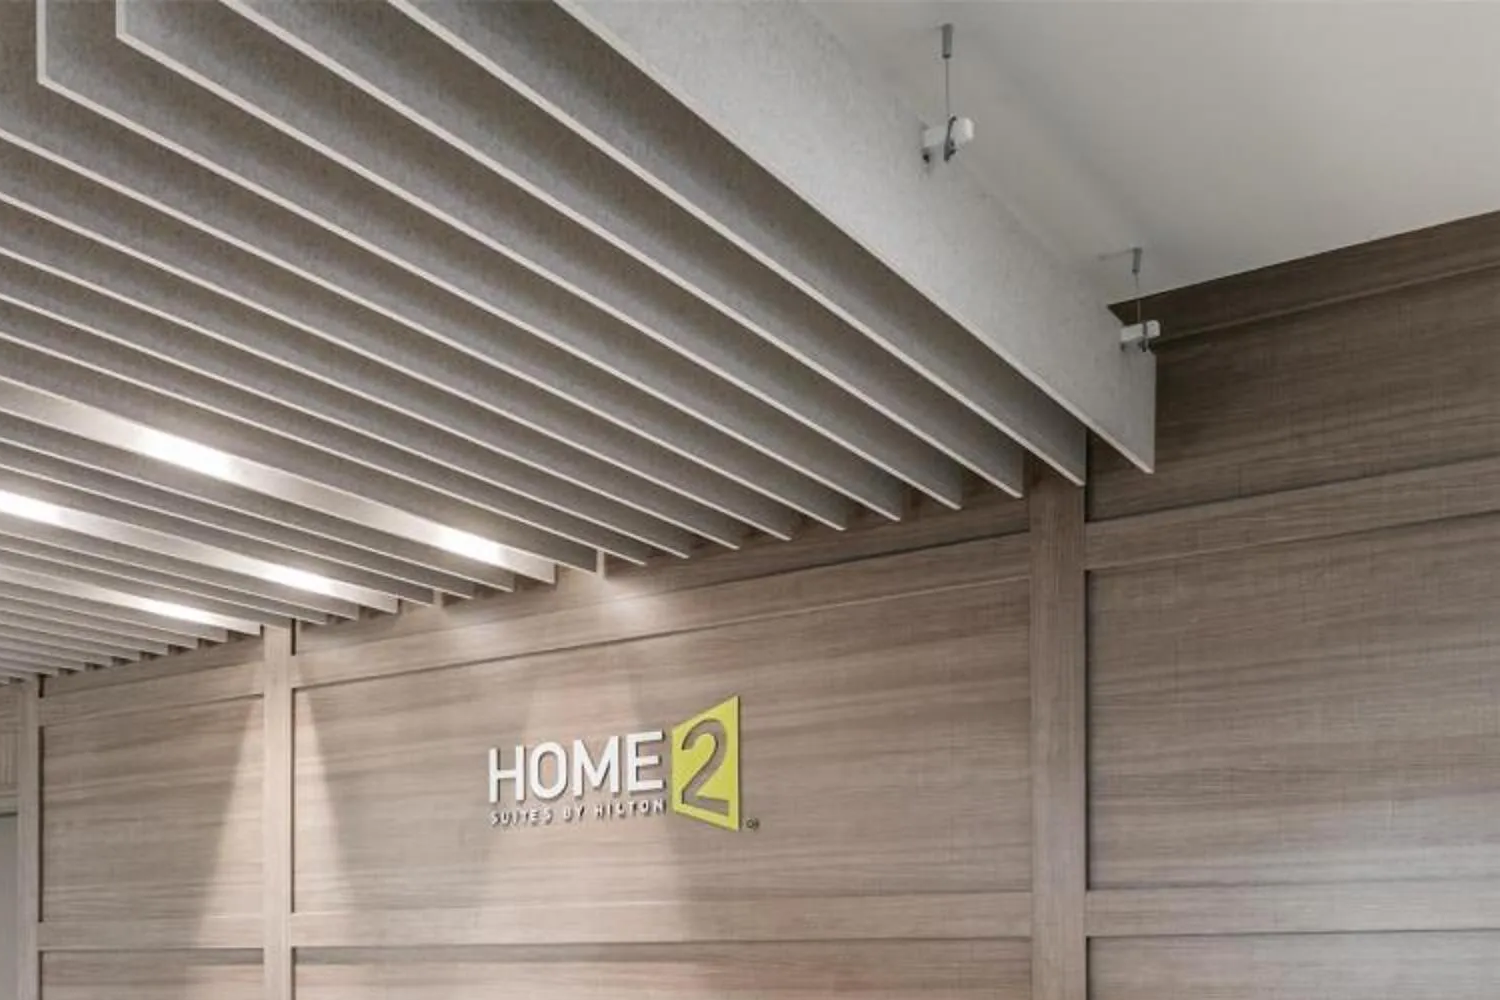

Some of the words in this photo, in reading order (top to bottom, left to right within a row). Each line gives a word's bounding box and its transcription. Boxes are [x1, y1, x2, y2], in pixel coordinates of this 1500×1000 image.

[488, 730, 664, 803] HOME
[491, 808, 553, 827] SUITES
[596, 799, 667, 819] HILTON
